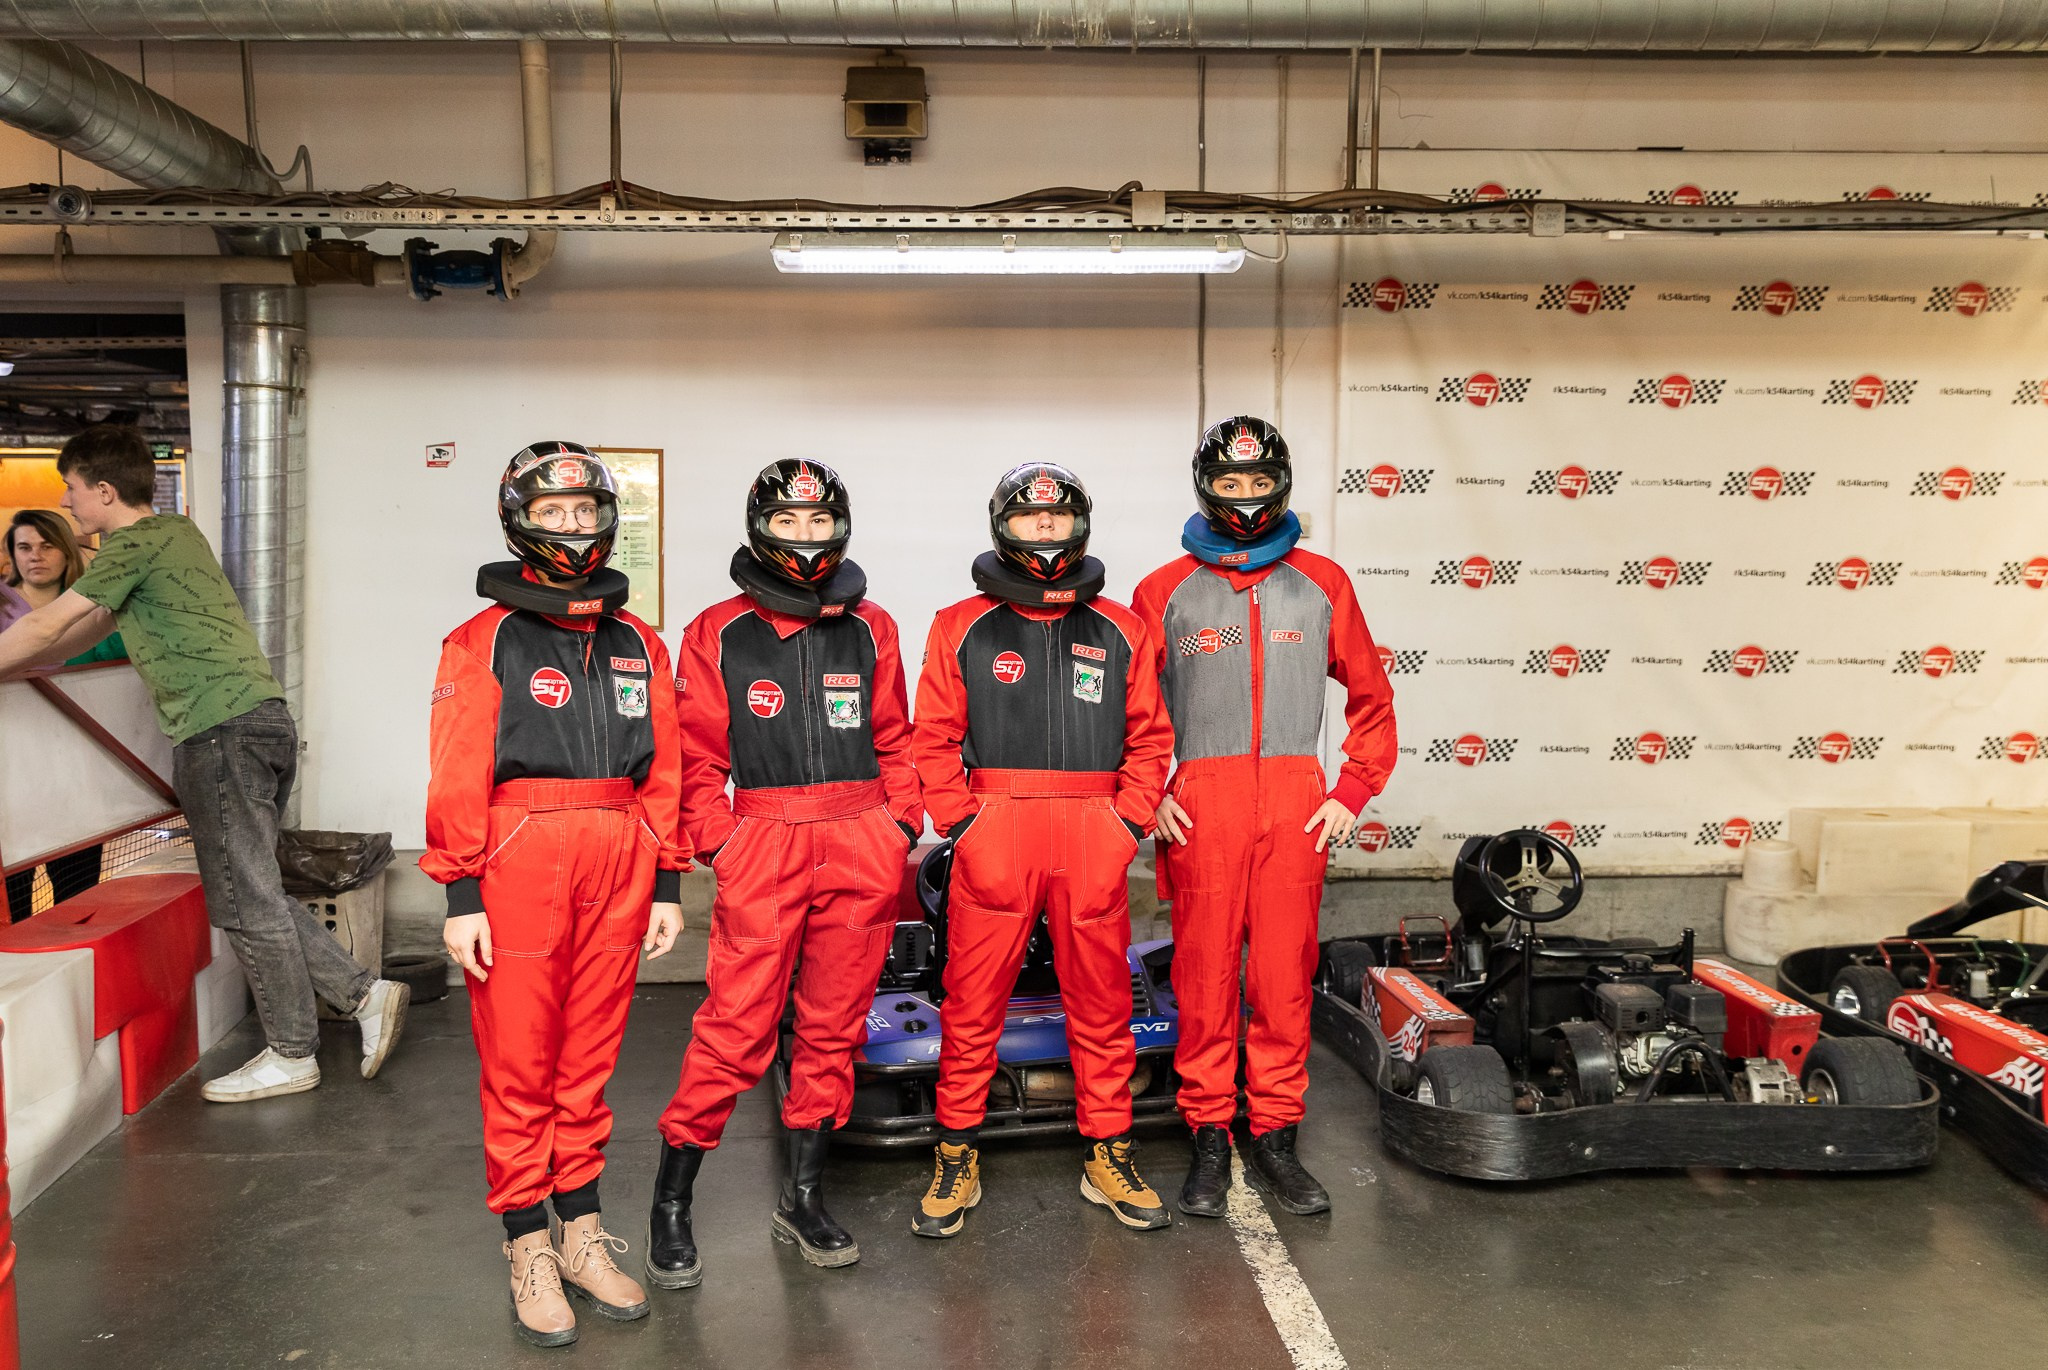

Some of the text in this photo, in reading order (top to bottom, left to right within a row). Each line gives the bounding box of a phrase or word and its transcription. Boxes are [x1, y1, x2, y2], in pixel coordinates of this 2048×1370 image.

[572, 602, 600, 610] RLG
[1274, 632, 1300, 641] RLG
[1076, 647, 1102, 658] RLG
[615, 660, 642, 669] RLG
[1130, 1021, 1170, 1034] EVO
[1402, 1030, 1416, 1056] 24
